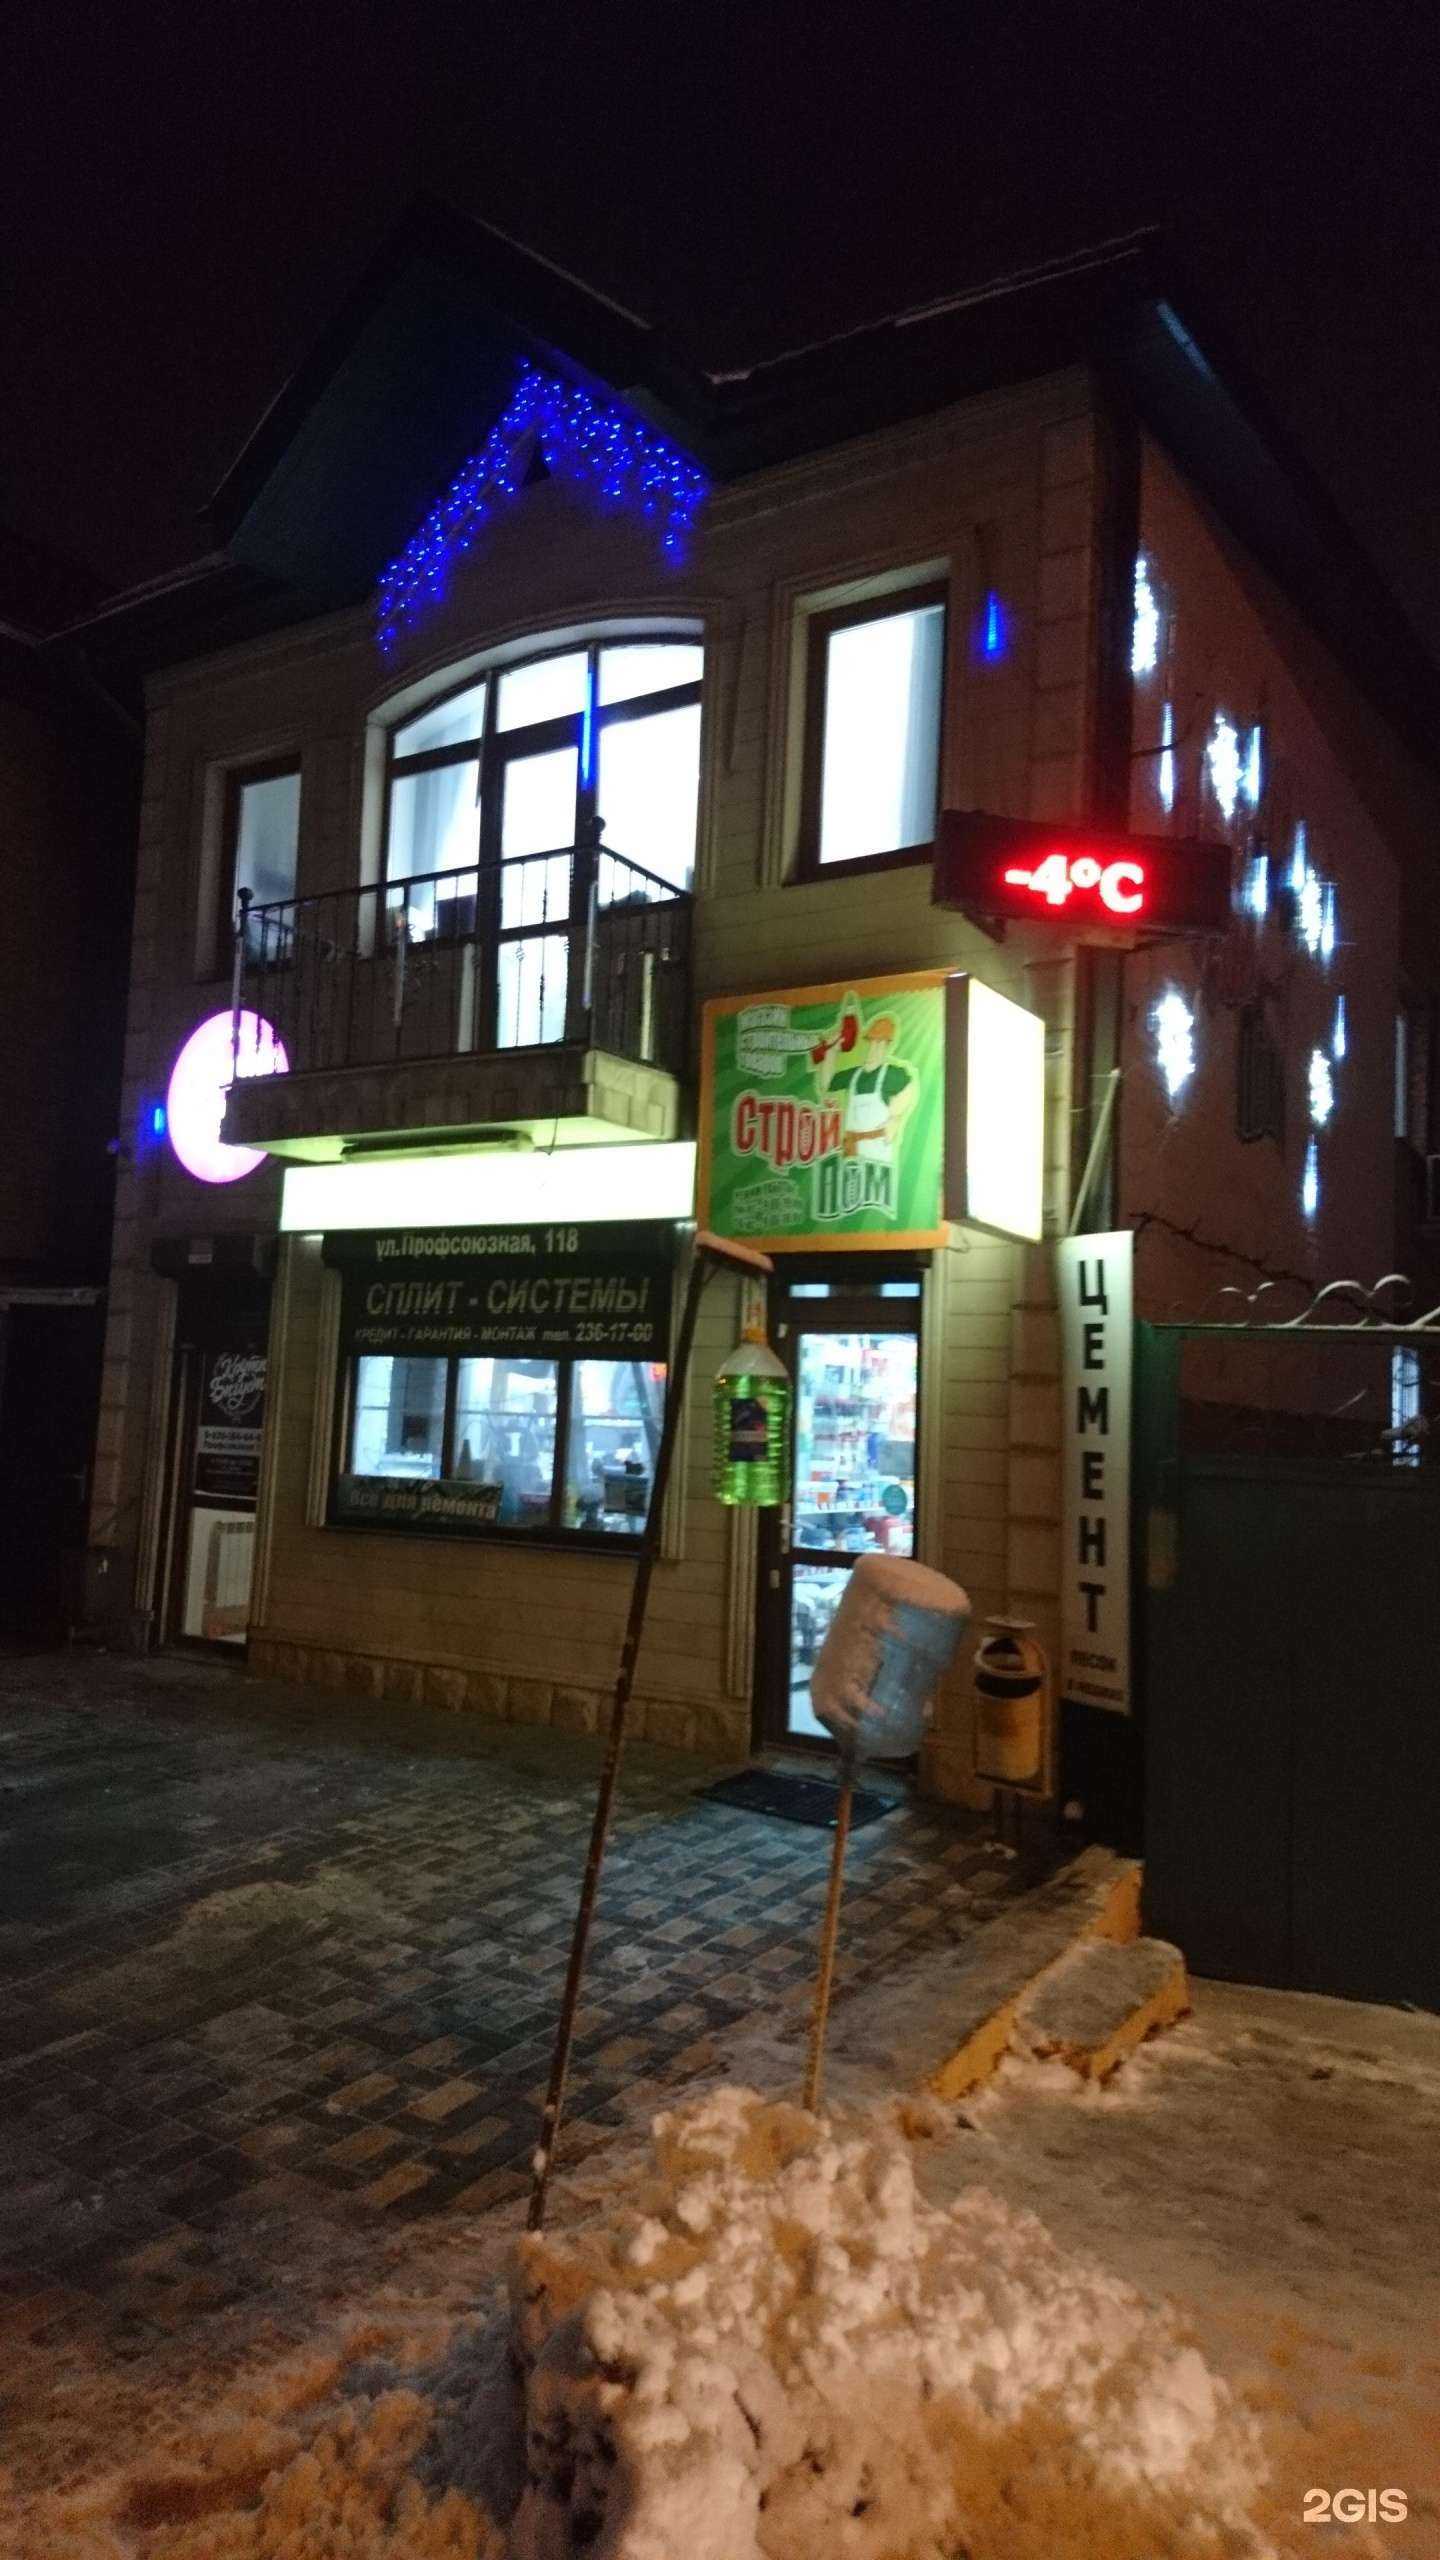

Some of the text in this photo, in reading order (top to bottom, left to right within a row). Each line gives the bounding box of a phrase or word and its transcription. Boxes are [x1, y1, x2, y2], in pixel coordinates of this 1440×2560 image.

[545, 1228, 579, 1254] 118
[365, 1281, 464, 1316] СПЛИТ
[486, 1276, 652, 1315] СИСТЕМЫ
[407, 1325, 473, 1341] ГАРАНТИЯ
[480, 1325, 538, 1341] МОНТАЖ
[1075, 1258, 1109, 1633] ЦЕМЕНТ
